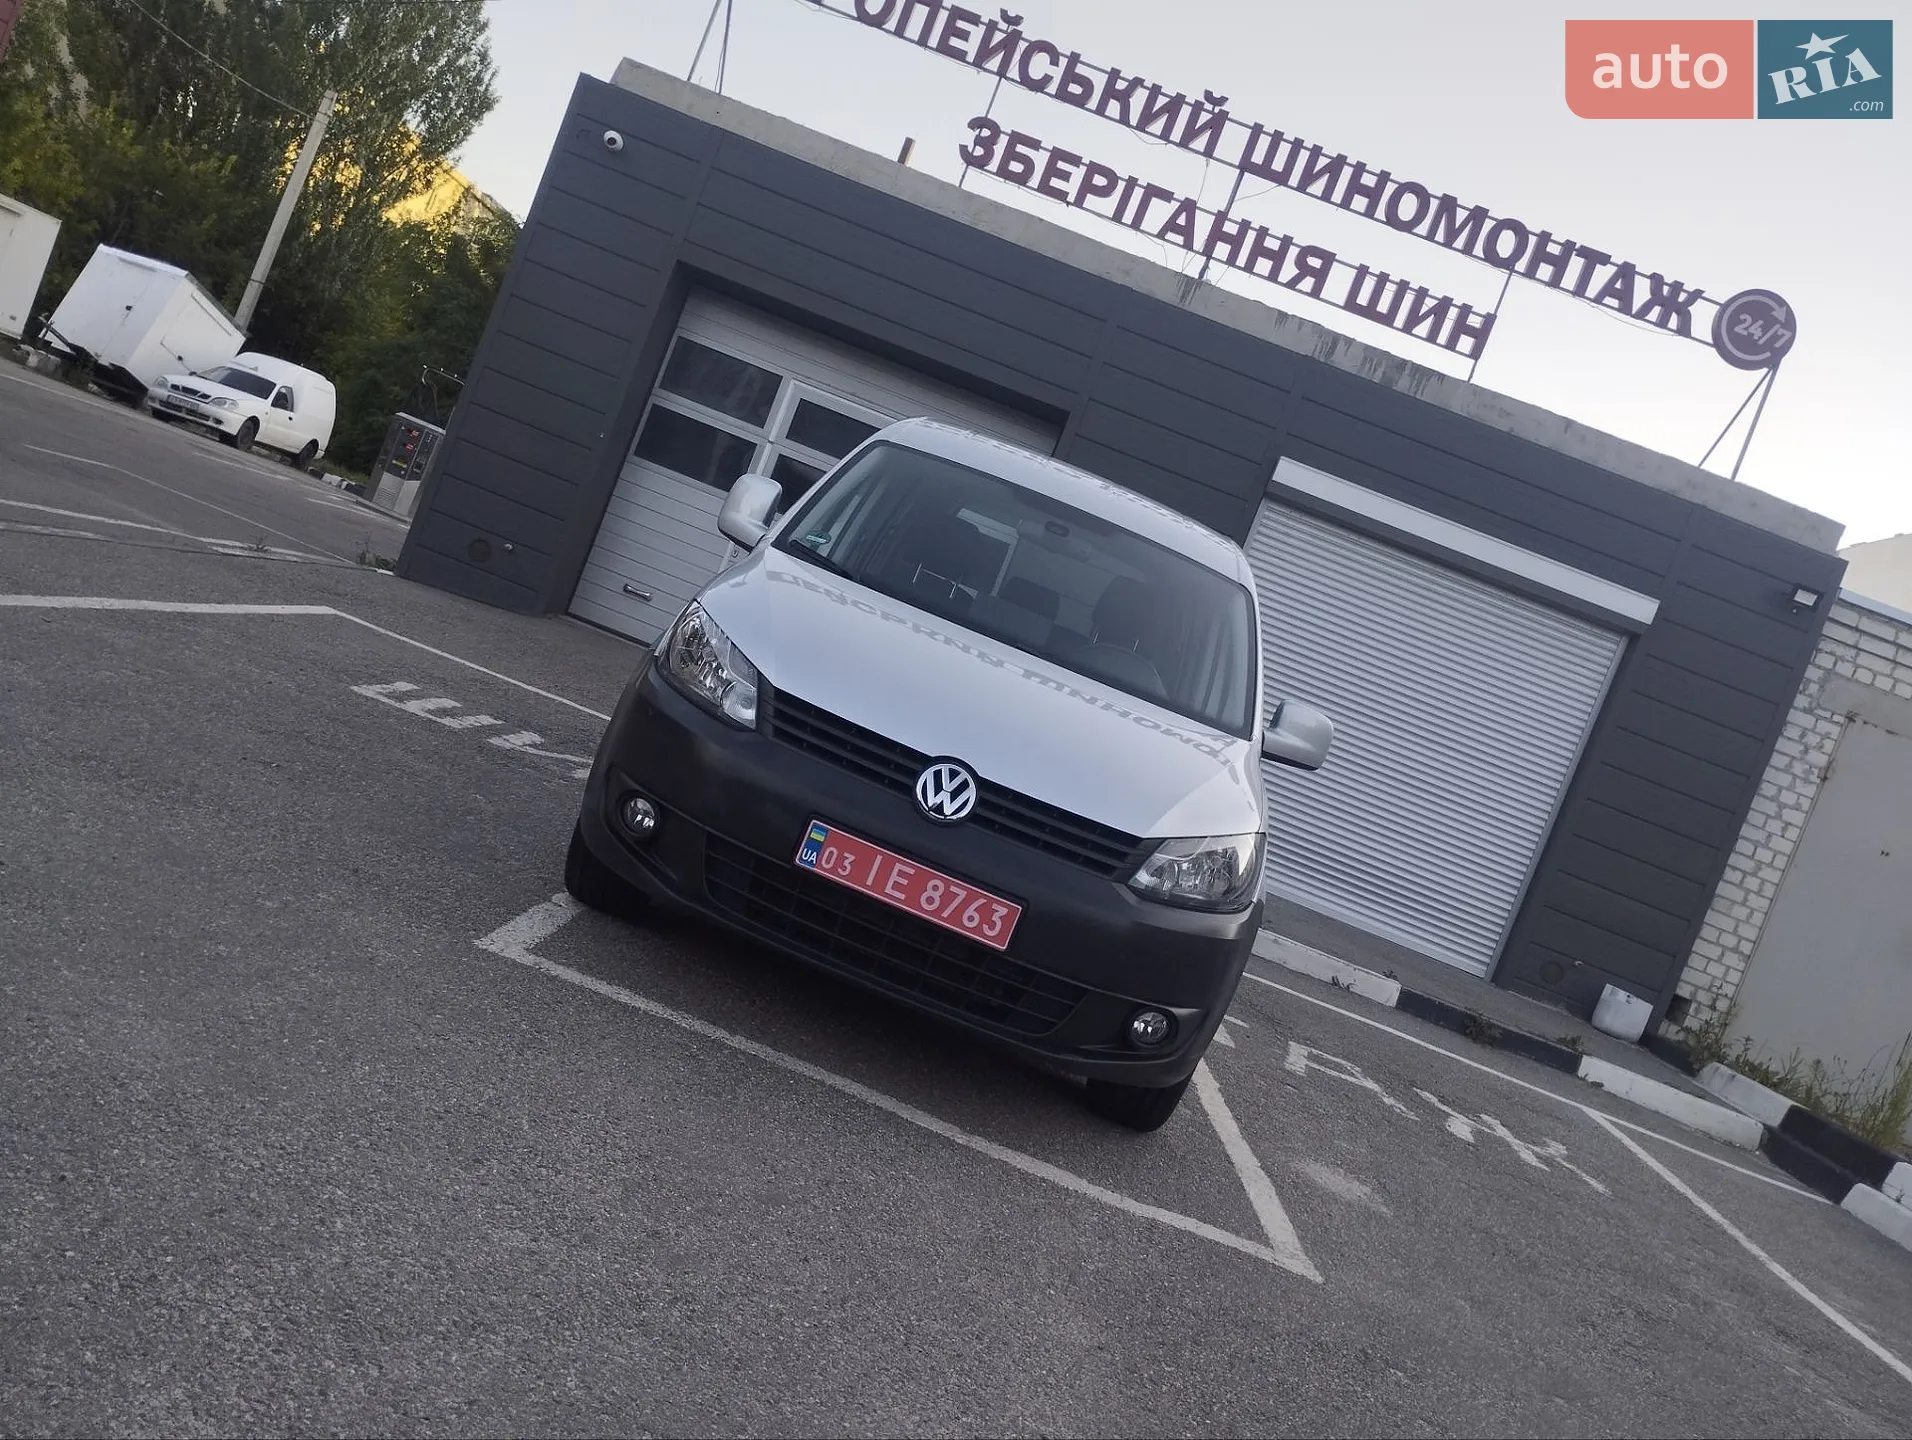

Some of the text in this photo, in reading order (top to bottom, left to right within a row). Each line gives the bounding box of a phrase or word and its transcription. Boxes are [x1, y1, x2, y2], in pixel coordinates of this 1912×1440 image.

[958, 116, 1497, 360] ЗБЕРІГАННЯ ШИН
[1239, 121, 1706, 339] ШИНОМОНТАЖ
[1733, 313, 1793, 348] 24/7
[801, 848, 818, 865] UA
[820, 846, 1009, 937] 03 IE 8763
